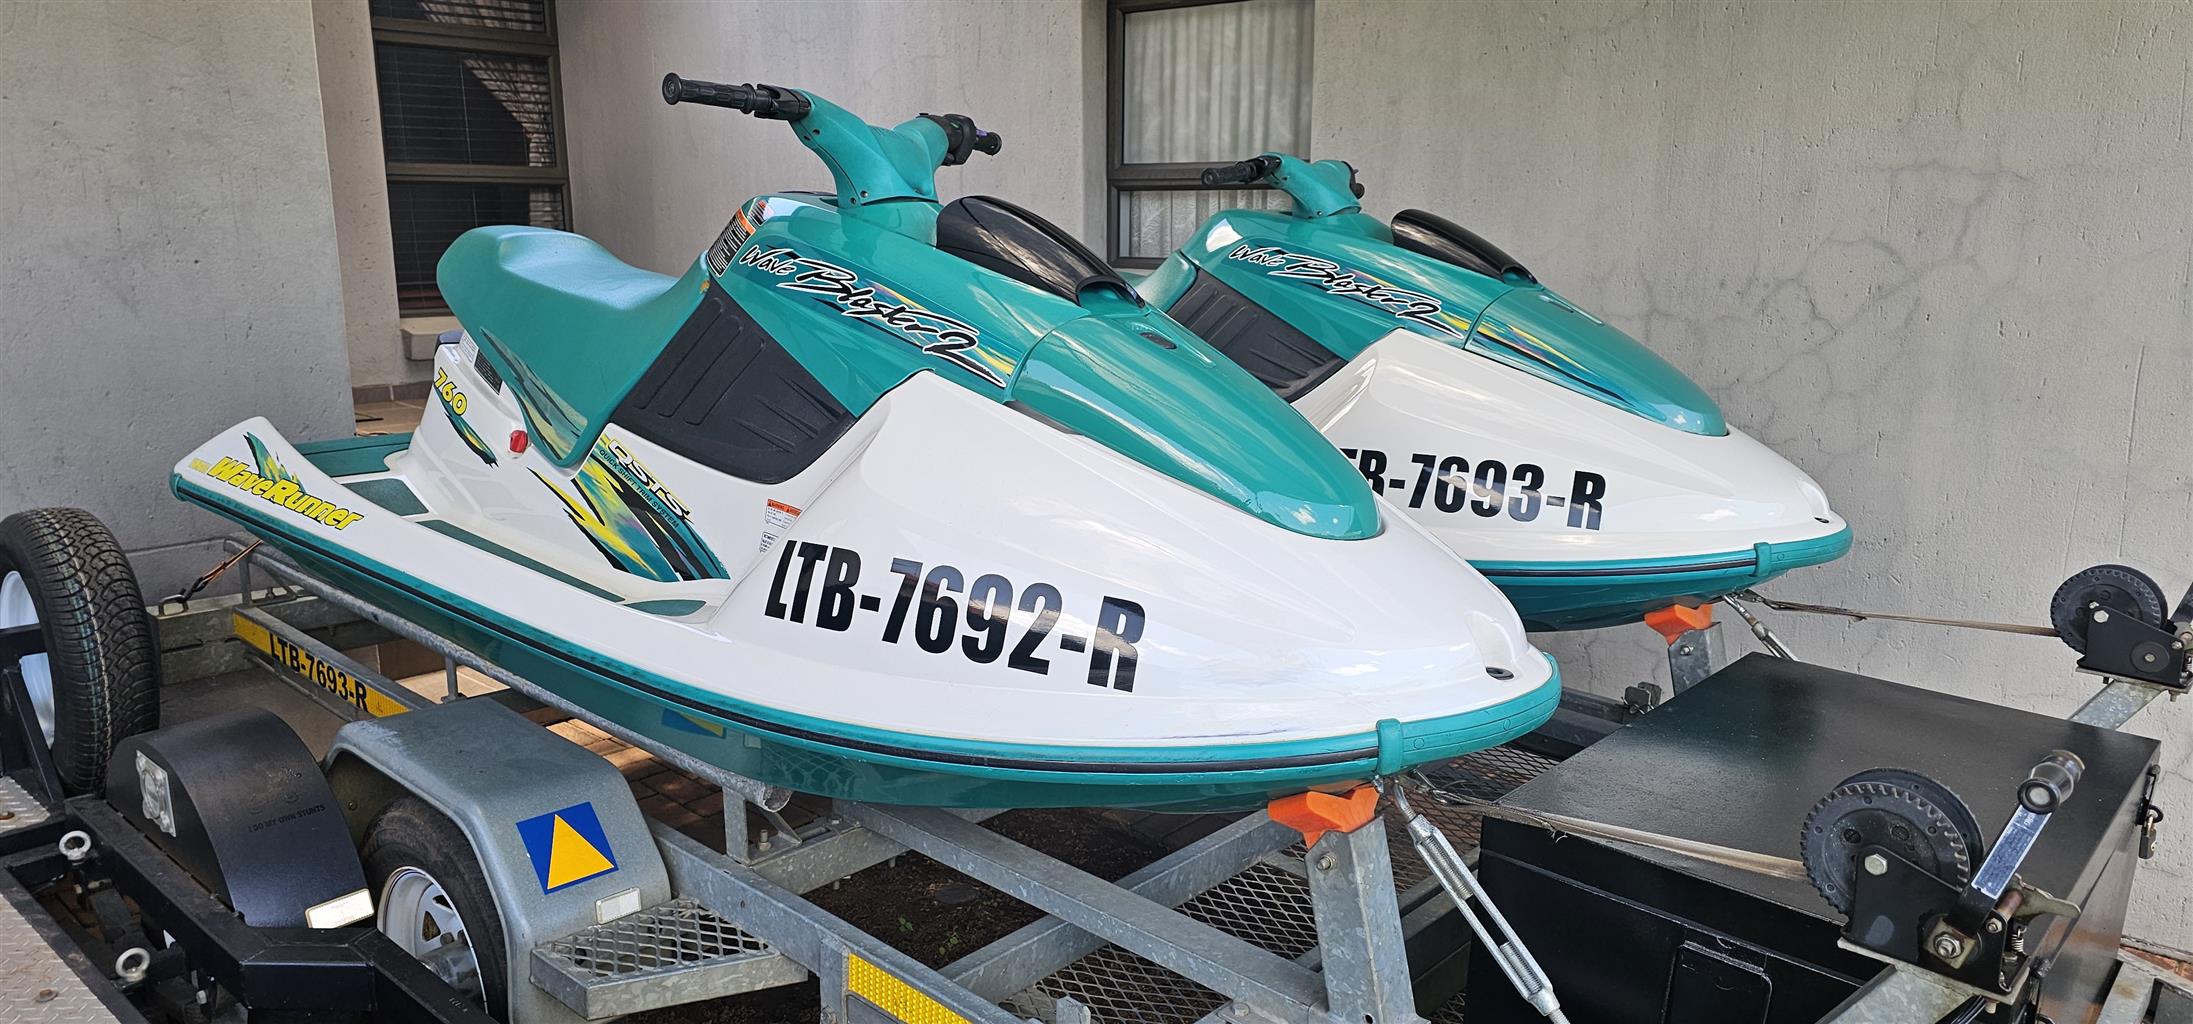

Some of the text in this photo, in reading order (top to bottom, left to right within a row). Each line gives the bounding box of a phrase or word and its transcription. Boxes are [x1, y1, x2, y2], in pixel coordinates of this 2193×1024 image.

[739, 244, 1006, 388] Wave Blaster 2
[1228, 245, 1464, 339] Wave Blaster 2
[434, 366, 467, 416] 760
[206, 456, 364, 530] WaveRunner
[599, 449, 680, 529] QUICK SHIFT TRIM SYSTEM
[607, 440, 690, 519] QSTS
[1339, 447, 1606, 531] B-7693-R
[764, 540, 1146, 693] LTB-7692-R
[269, 632, 368, 713] LTB-7693-R
[296, 804, 326, 818] STUNTS
